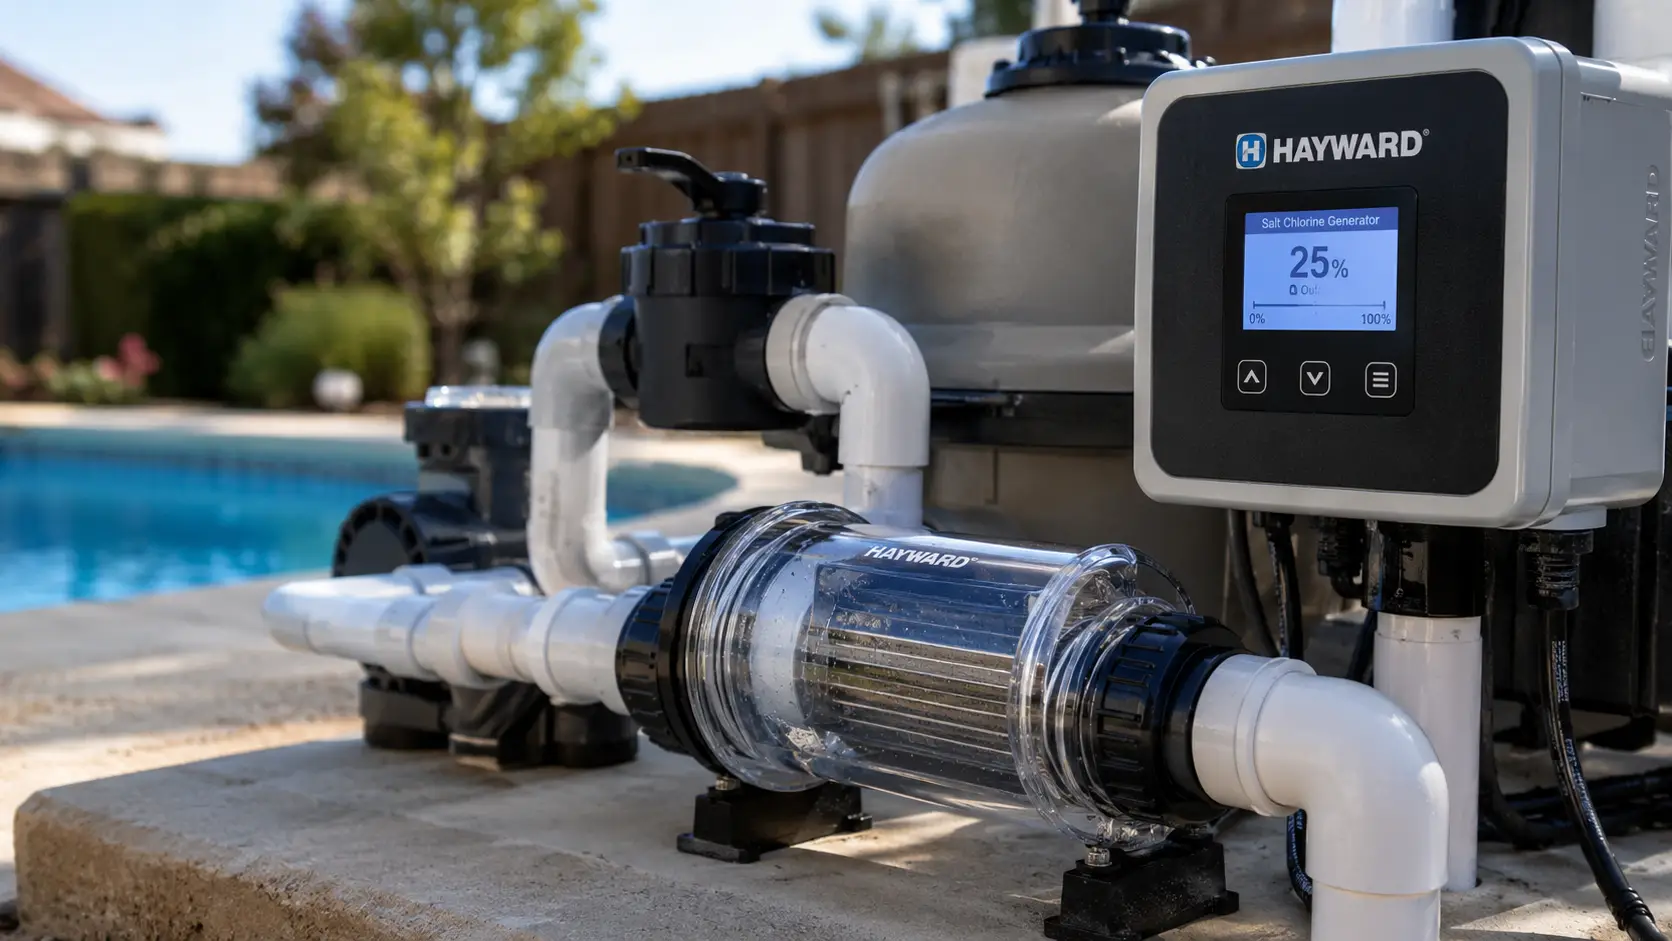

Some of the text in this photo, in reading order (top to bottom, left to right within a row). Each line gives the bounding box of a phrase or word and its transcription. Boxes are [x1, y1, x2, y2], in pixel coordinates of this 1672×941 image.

[1262, 214, 1380, 229] Salt Chlorine Generator
[1290, 245, 1349, 278] 25%
[1249, 312, 1266, 324] 0%
[1361, 313, 1391, 325] 100%
